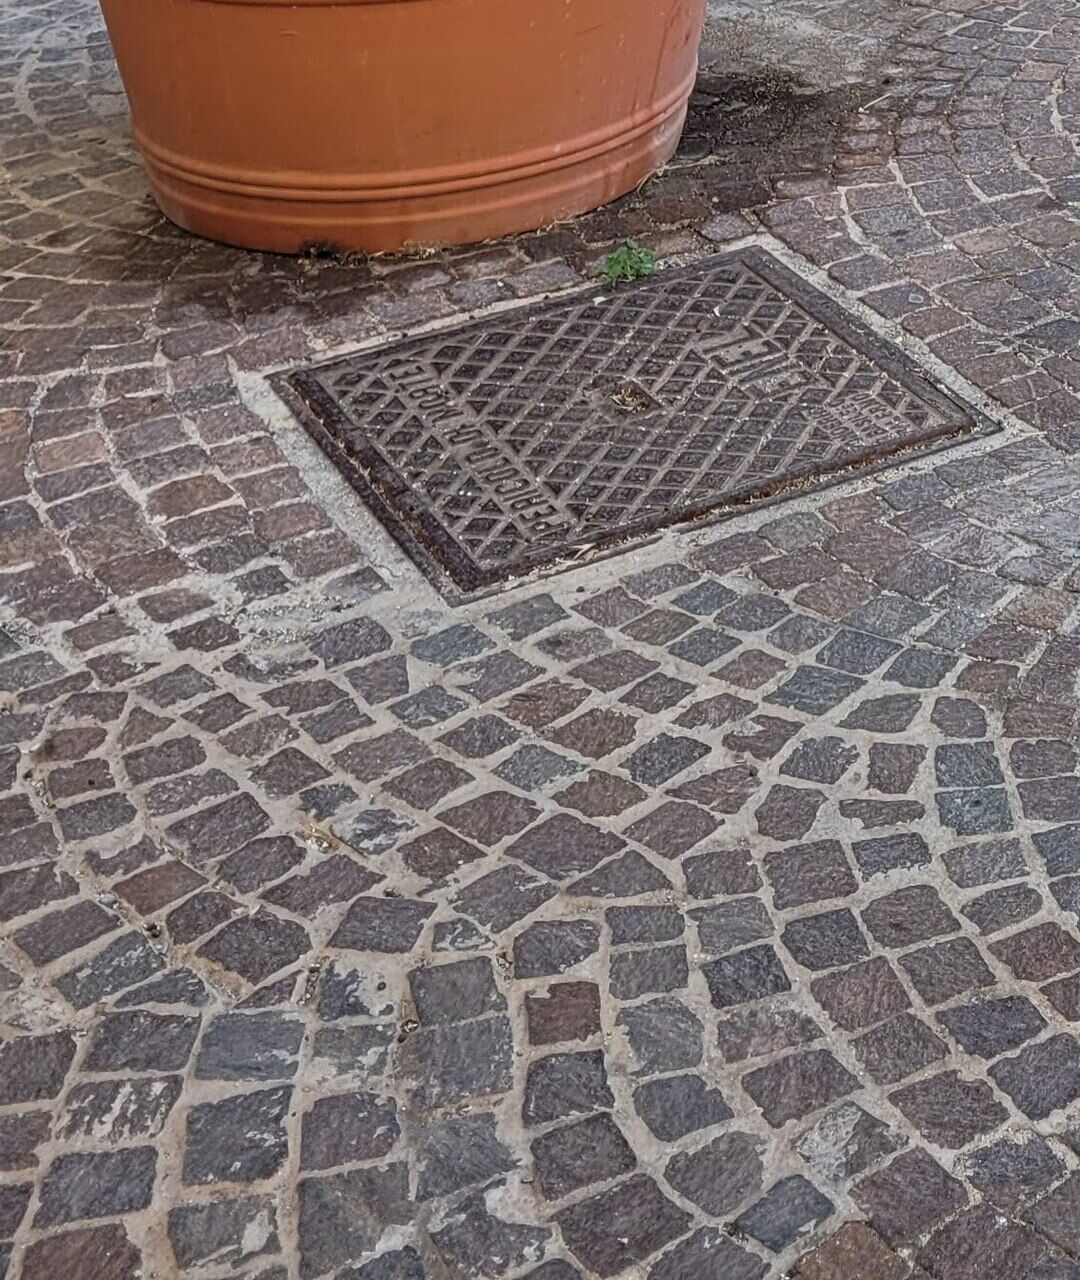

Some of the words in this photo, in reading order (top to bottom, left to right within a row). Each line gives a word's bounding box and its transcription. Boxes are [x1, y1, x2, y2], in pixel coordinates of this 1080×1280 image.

[387, 365, 466, 423] MORTE
[701, 325, 818, 400] ENEL
[460, 446, 572, 537] PERICOLO
